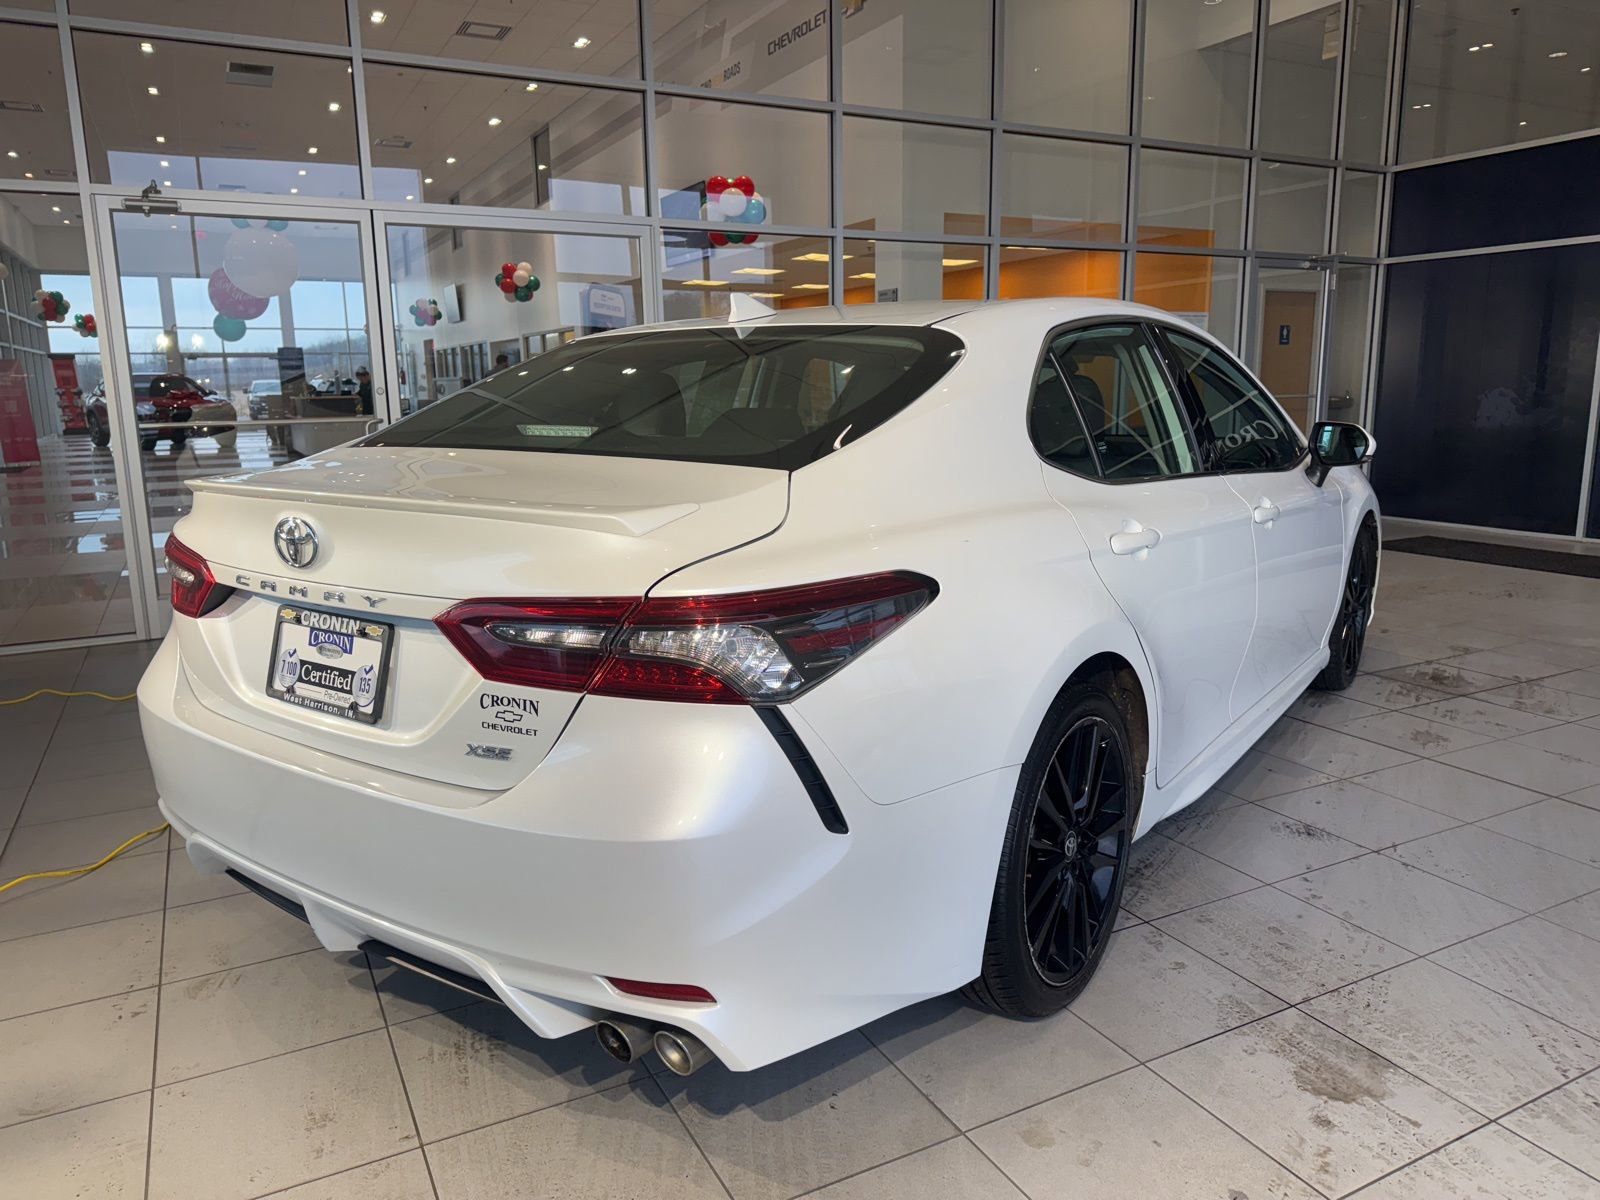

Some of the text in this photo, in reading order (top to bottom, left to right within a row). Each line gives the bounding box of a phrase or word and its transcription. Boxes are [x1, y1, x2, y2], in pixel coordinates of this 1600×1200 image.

[767, 9, 828, 56] CHEVROLET
[723, 61, 741, 82] ROADS
[235, 574, 388, 608] CAMRY
[300, 610, 361, 636] CRONIN
[311, 630, 352, 654] CRONIN
[301, 664, 352, 691] Certified
[358, 677, 372, 694] 135
[283, 693, 302, 705] West
[324, 690, 351, 705] Pre-Owned
[480, 693, 540, 718] CRONIN
[481, 721, 538, 737] CHEVROLET
[464, 743, 514, 761] XSE
